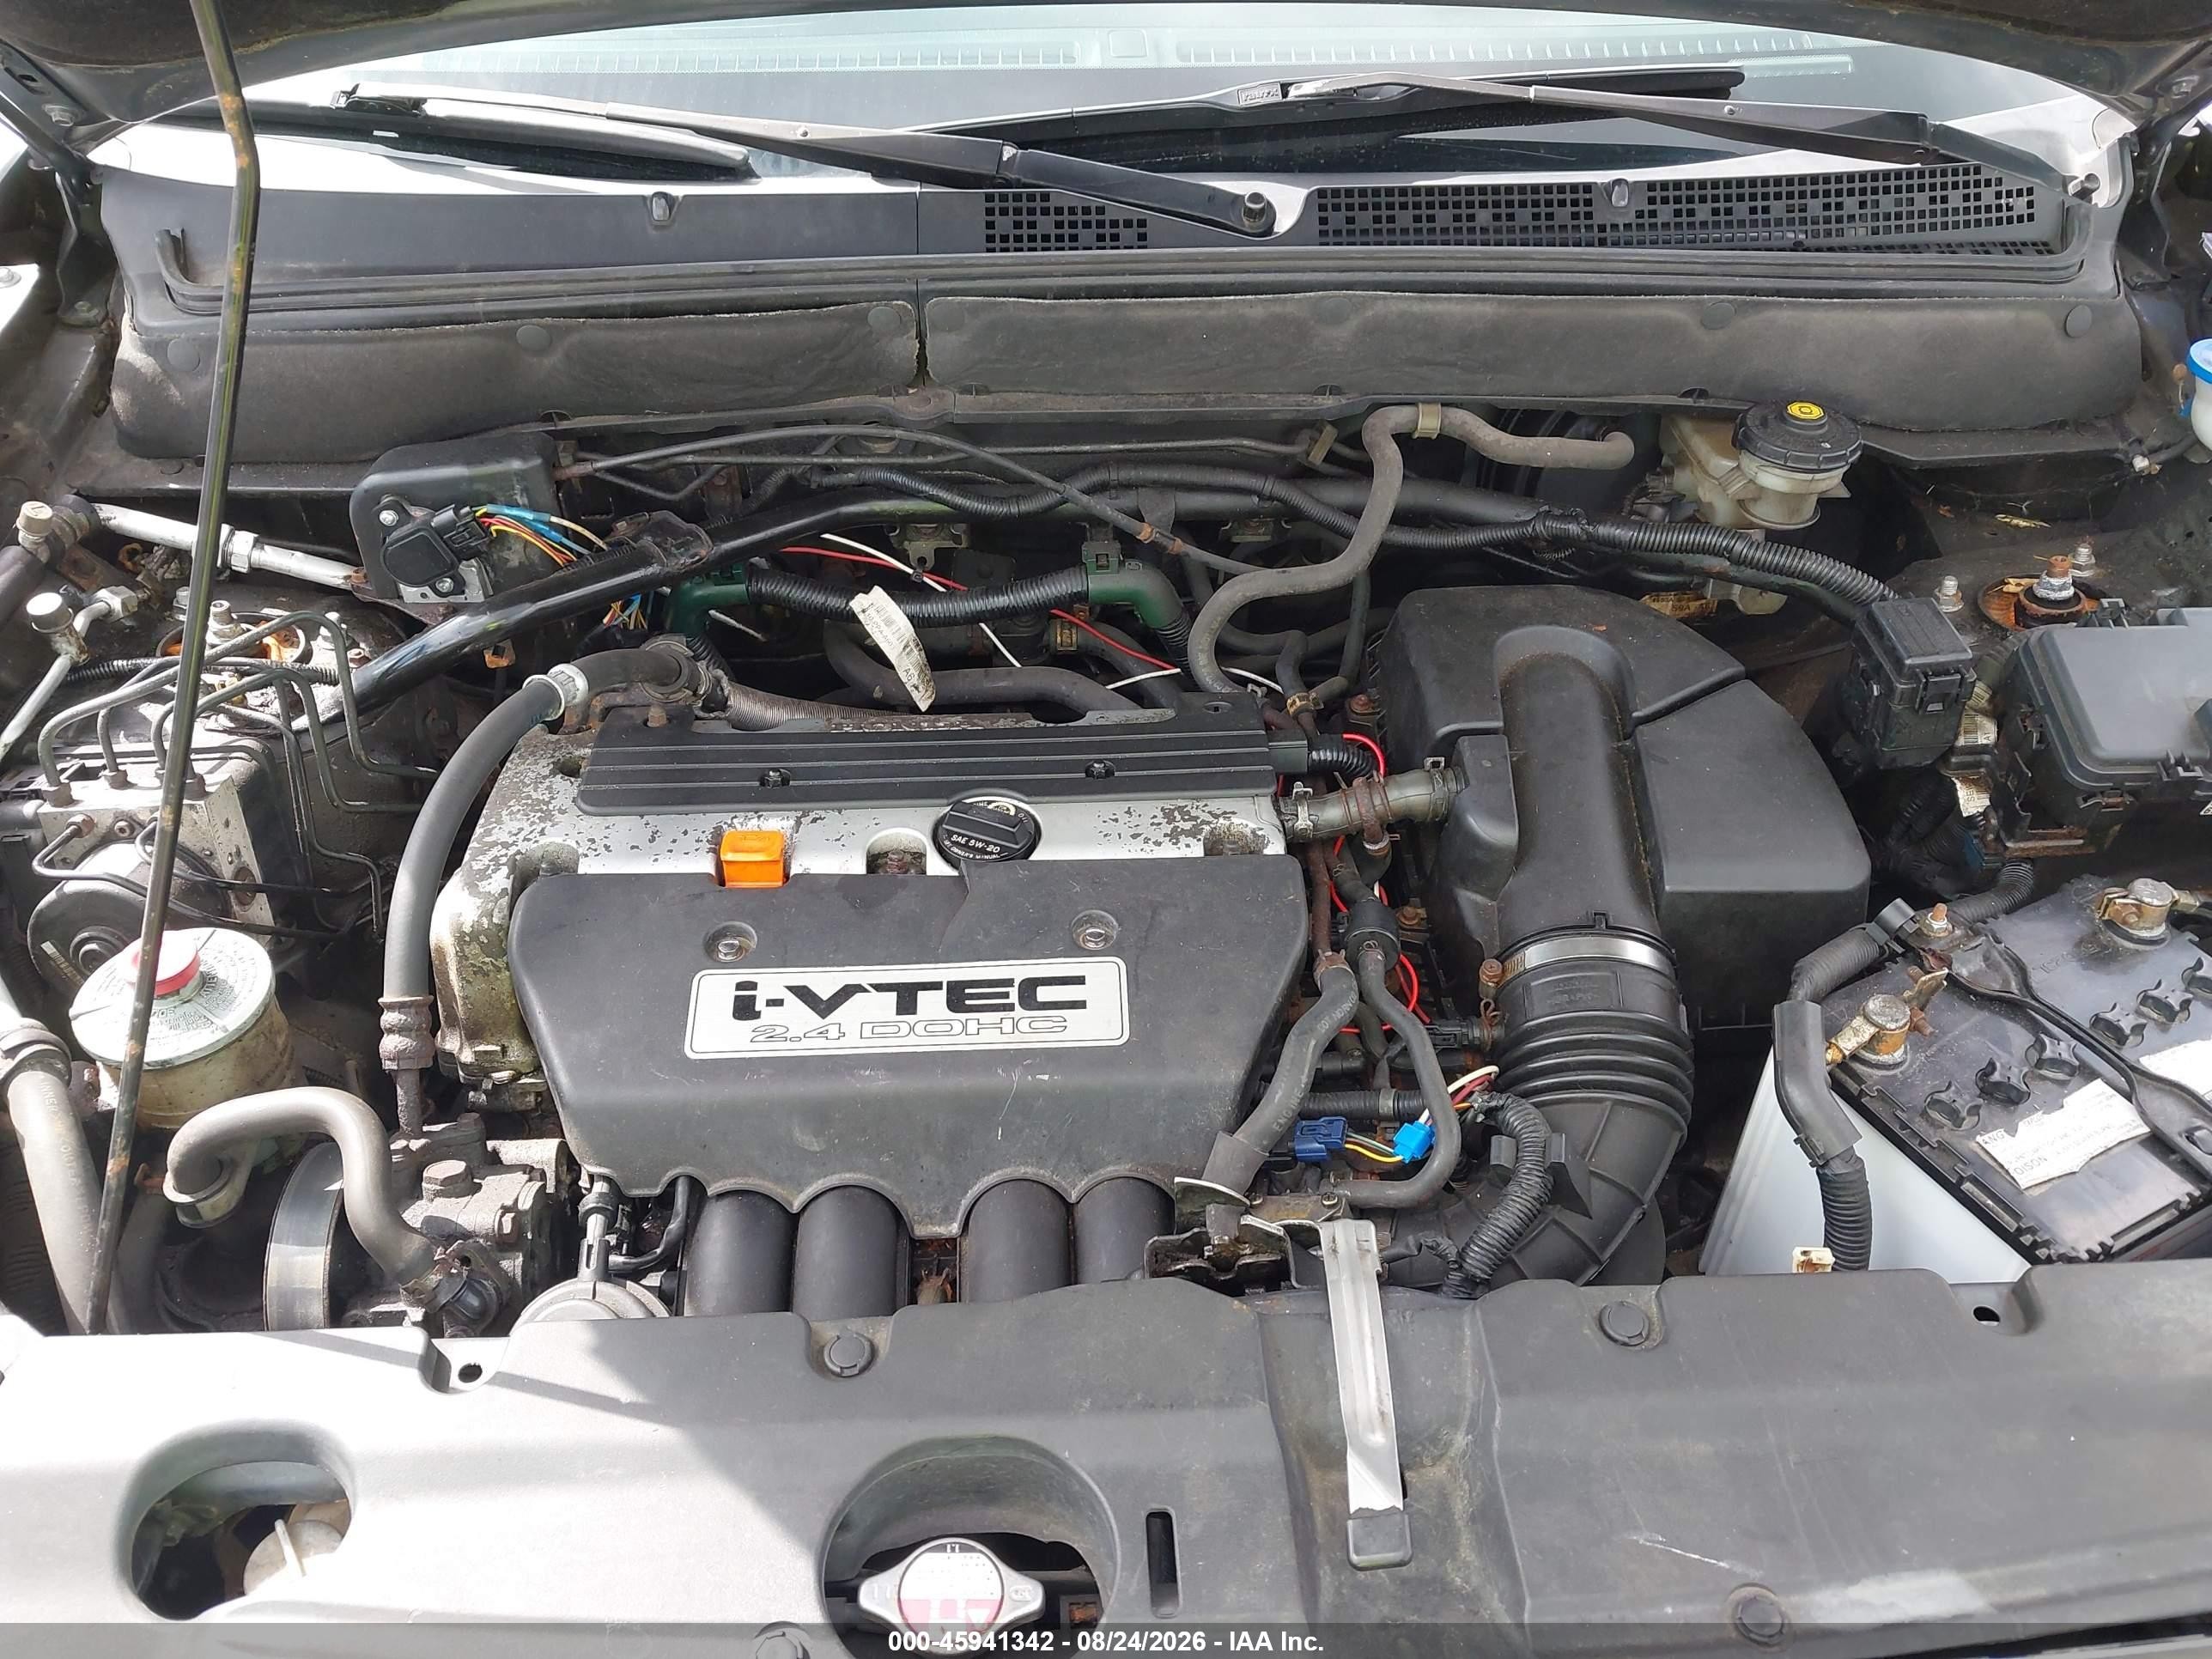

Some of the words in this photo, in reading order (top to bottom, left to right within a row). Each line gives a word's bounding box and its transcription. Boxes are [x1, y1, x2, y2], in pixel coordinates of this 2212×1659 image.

[951, 834, 967, 845] SAE
[731, 975, 1088, 1022] i-VTEC
[750, 1023, 846, 1044] 2.4
[860, 1015, 1068, 1040] DOHC
